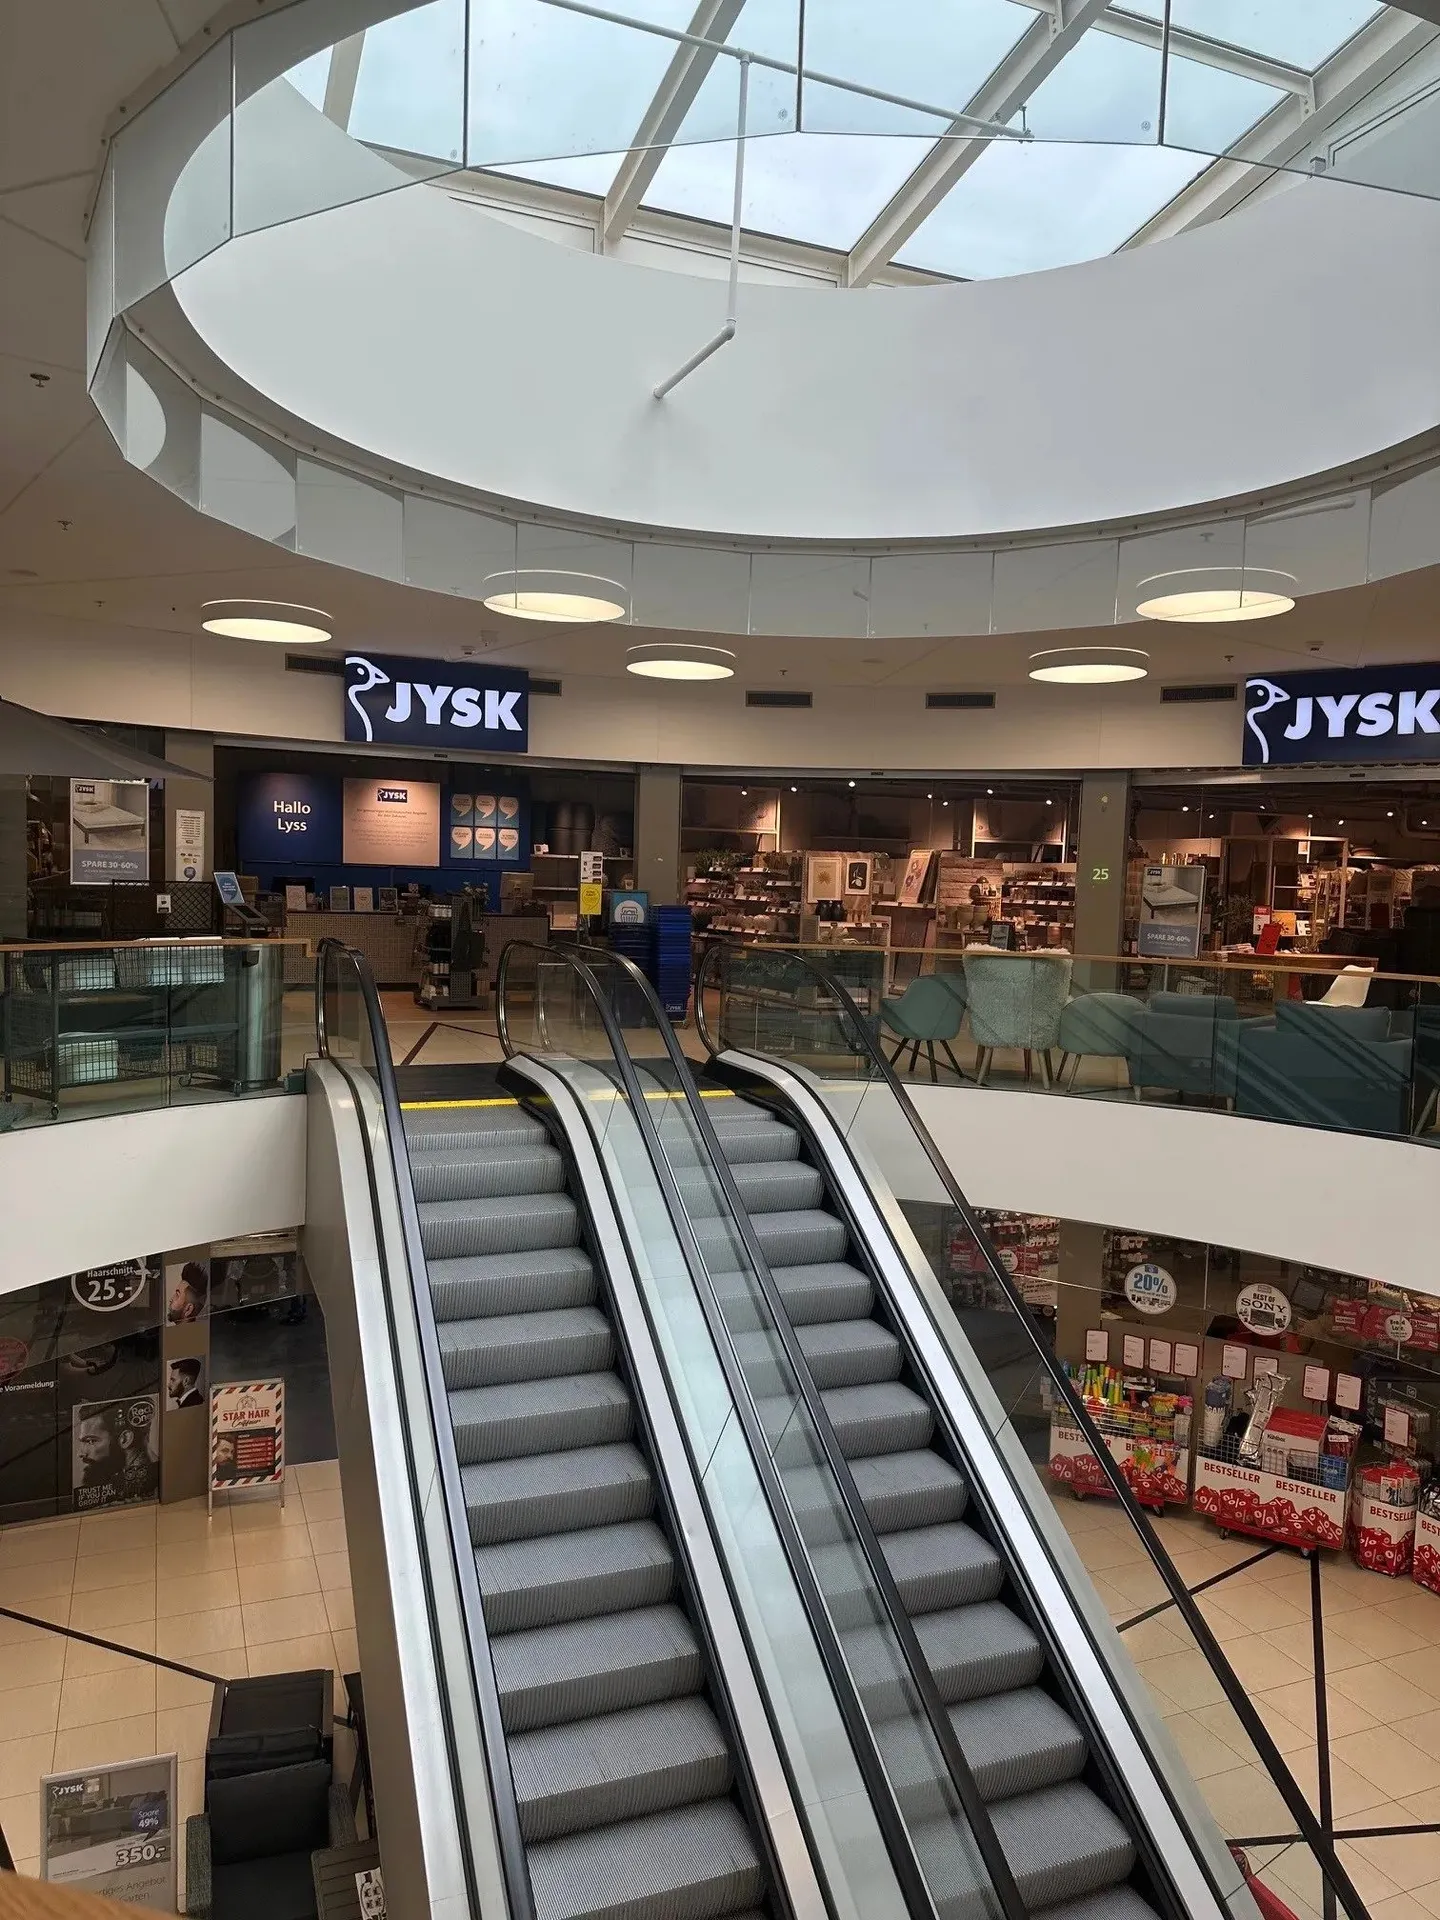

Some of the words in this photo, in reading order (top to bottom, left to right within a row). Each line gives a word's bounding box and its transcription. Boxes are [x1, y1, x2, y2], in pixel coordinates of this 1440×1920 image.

[385, 682, 522, 731] JYSK
[1284, 690, 1440, 740] JYSK
[383, 791, 407, 800] JYSK
[273, 800, 311, 814] Hallo
[277, 818, 308, 833] Lyss
[82, 860, 107, 869] SPARE
[108, 861, 139, 870] 30-60%
[1092, 868, 1109, 880] 25
[1147, 933, 1166, 942] SPARE
[1166, 935, 1191, 943] 30-60%
[87, 1266, 133, 1278] Haarschnitt
[1133, 1272, 1168, 1294] 20%
[88, 1278, 133, 1302] 25.-
[1252, 1292, 1268, 1302] BEST
[1241, 1297, 1287, 1313] SONY
[4, 1380, 55, 1393] Voranmeldung
[222, 1411, 245, 1421] STAR
[248, 1409, 270, 1419] HAIR
[1204, 1462, 1261, 1484] BESTSELLER
[78, 1486, 101, 1496] TRUST
[102, 1483, 113, 1491] ME
[87, 1491, 100, 1499] YOU
[102, 1489, 116, 1497] CAN
[1276, 1480, 1337, 1503] BESTSELLER
[78, 1498, 99, 1507] GROW
[1370, 1506, 1416, 1522] BESTSELLE
[58, 1783, 84, 1795] JYSK
[138, 1817, 159, 1829] 49%
[116, 1844, 166, 1867] 350.-
